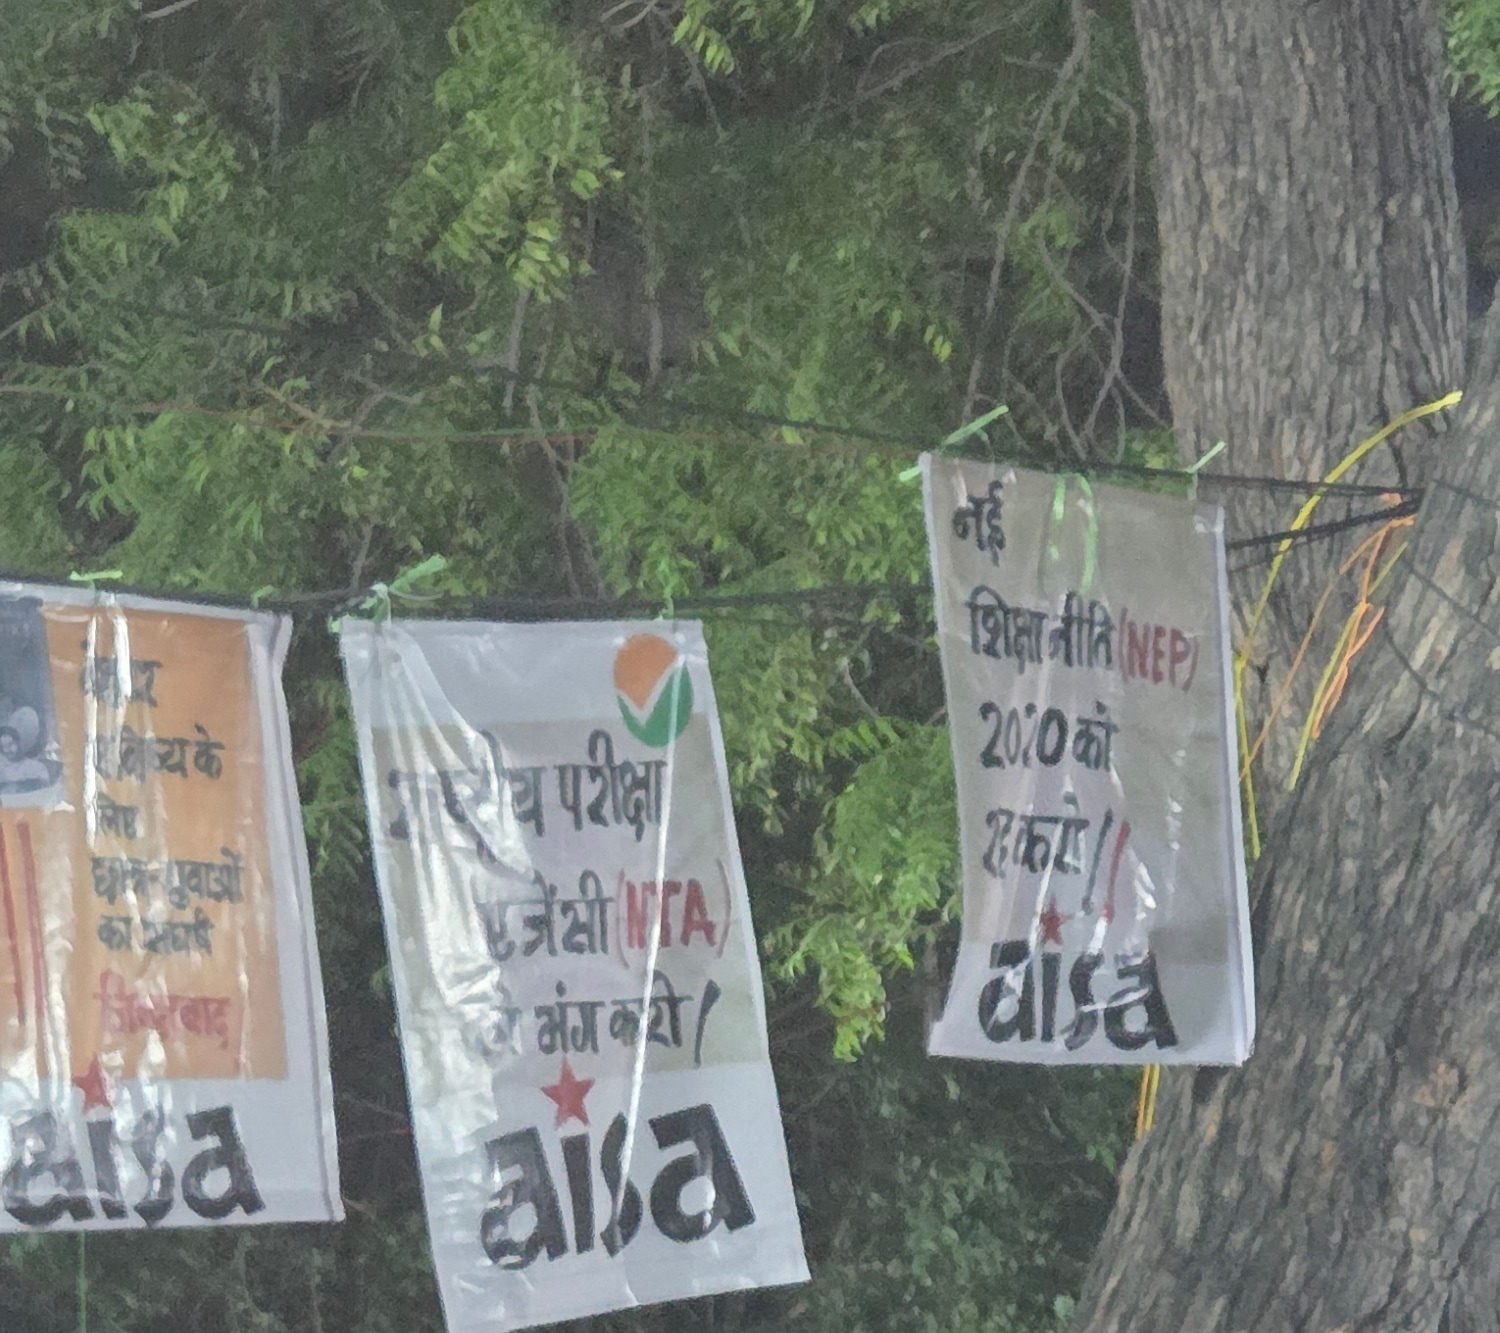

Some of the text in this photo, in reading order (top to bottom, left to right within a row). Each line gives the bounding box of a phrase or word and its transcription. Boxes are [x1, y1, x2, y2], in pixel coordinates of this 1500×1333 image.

[952, 480, 1006, 567] नई
[966, 585, 1049, 675] शिक्षा
[555, 728, 668, 842] परीक्षा
[978, 939, 1178, 1051] aisa
[480, 1103, 756, 1270] aisa
